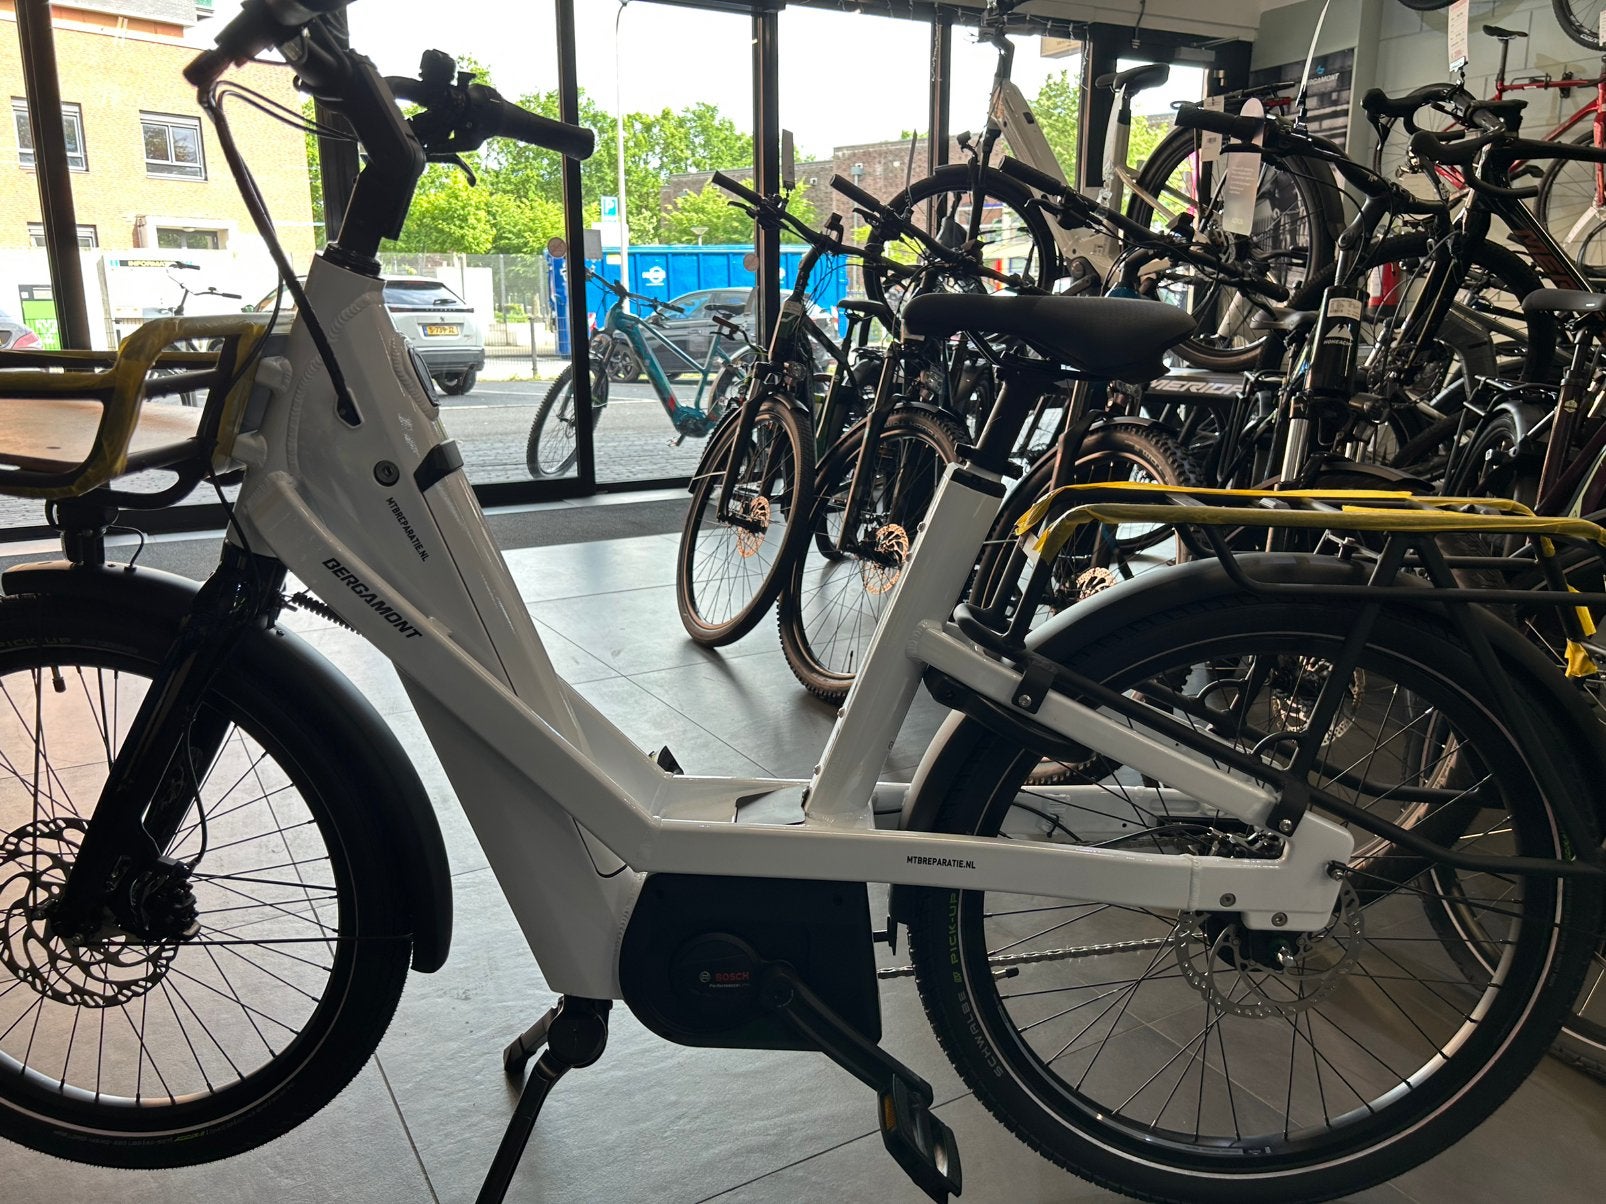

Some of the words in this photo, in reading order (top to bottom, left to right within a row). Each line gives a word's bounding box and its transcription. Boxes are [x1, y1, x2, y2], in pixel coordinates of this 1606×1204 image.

[385, 496, 430, 562] MTBREPARATIE.NL
[322, 557, 423, 639] BERGAMONT
[906, 855, 976, 869] MTBREPARATIE.NL
[948, 892, 959, 965] PICK-UP
[715, 971, 750, 982] BOSCH
[958, 991, 1004, 1077] SCHWALBE
